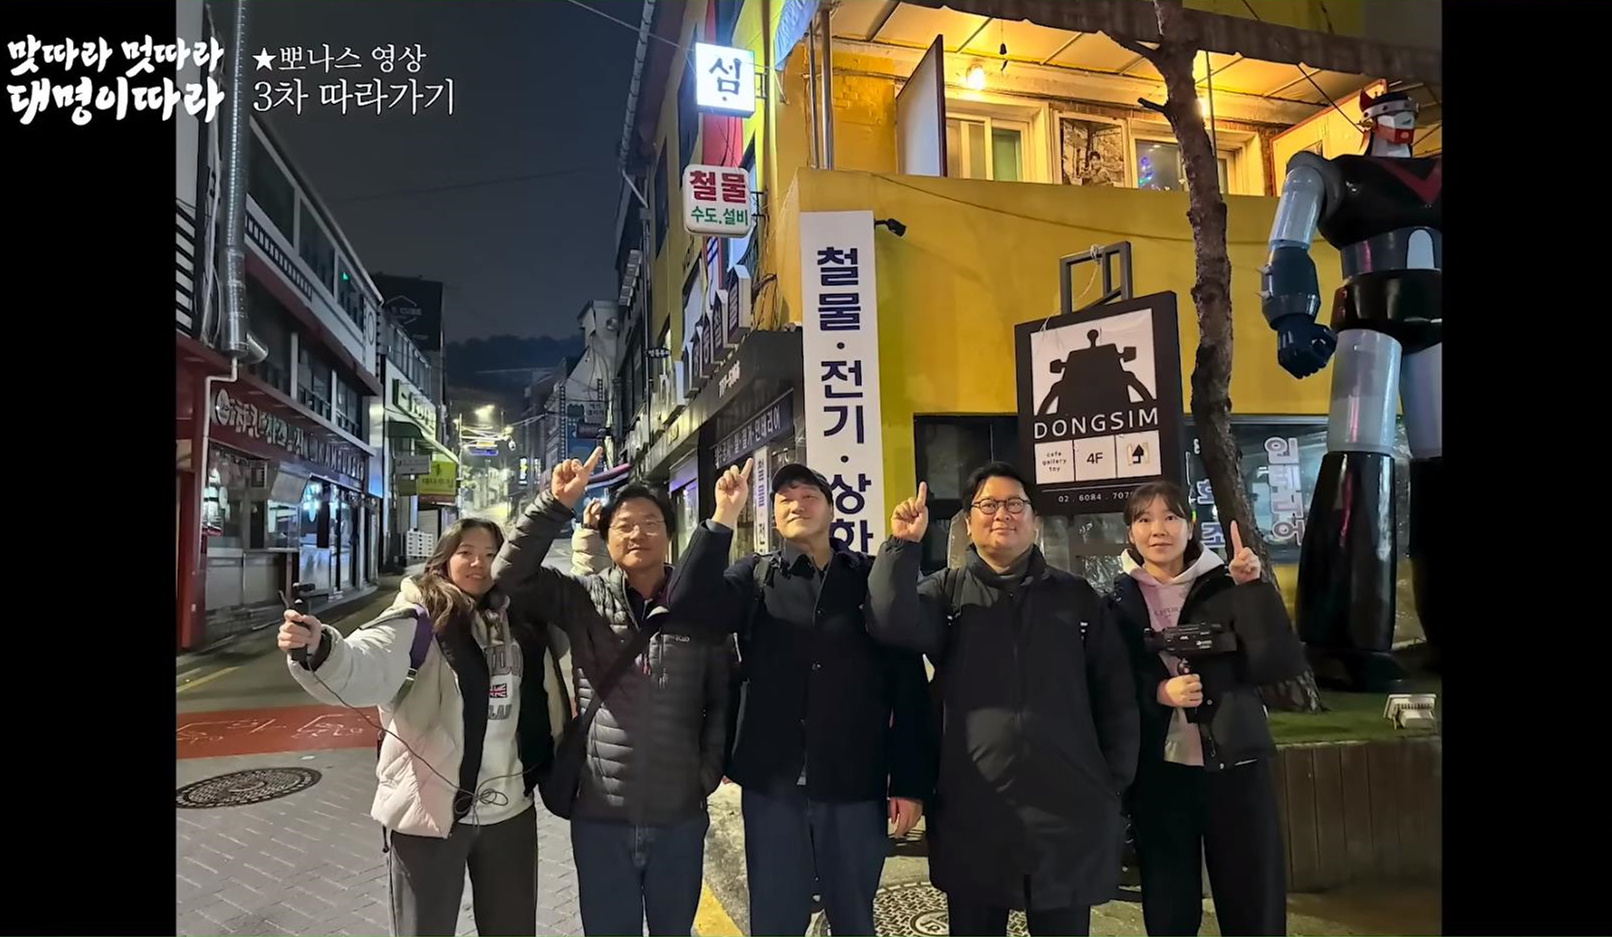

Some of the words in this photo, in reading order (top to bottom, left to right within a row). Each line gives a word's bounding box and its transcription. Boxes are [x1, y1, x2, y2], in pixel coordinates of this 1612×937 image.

[690, 170, 747, 204] 철물
[1034, 407, 1158, 439] DONGSIM
[1086, 452, 1103, 464] 4F
[1058, 495, 1069, 503] 02
